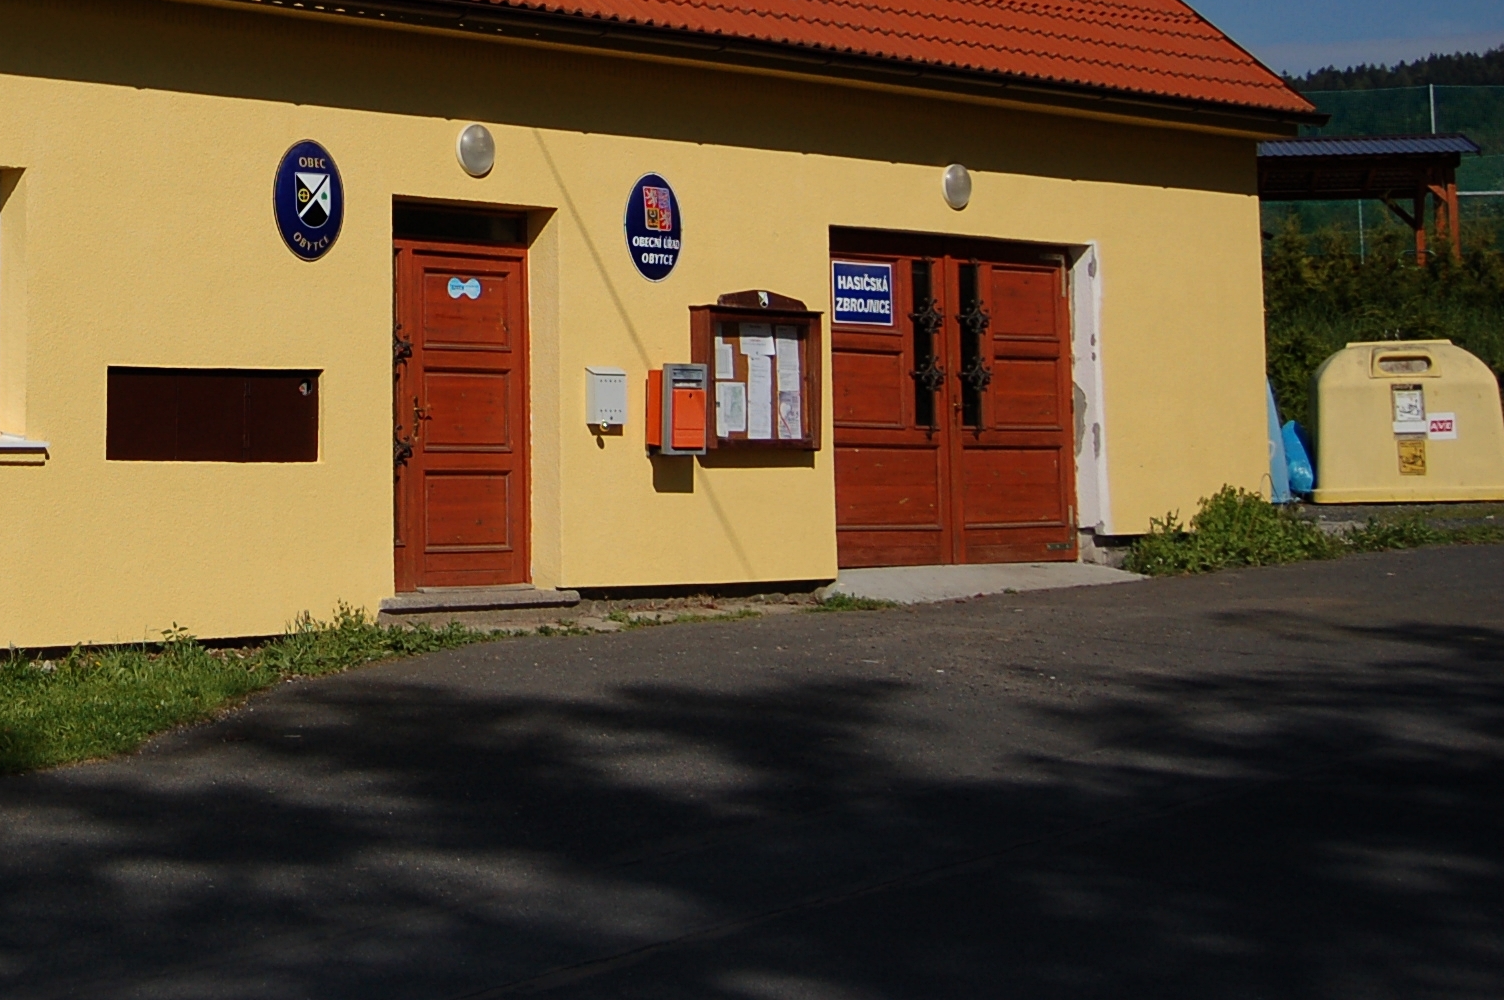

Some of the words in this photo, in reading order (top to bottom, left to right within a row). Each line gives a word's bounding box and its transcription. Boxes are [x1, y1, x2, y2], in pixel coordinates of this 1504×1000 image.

[298, 157, 326, 169] OBEC
[293, 231, 330, 251] OBYTCE
[632, 235, 662, 249] OBECNÍ
[641, 252, 674, 266] OBYTCE
[837, 273, 889, 292] HASIČSKÁ
[835, 297, 891, 315] ZBROJNICE
